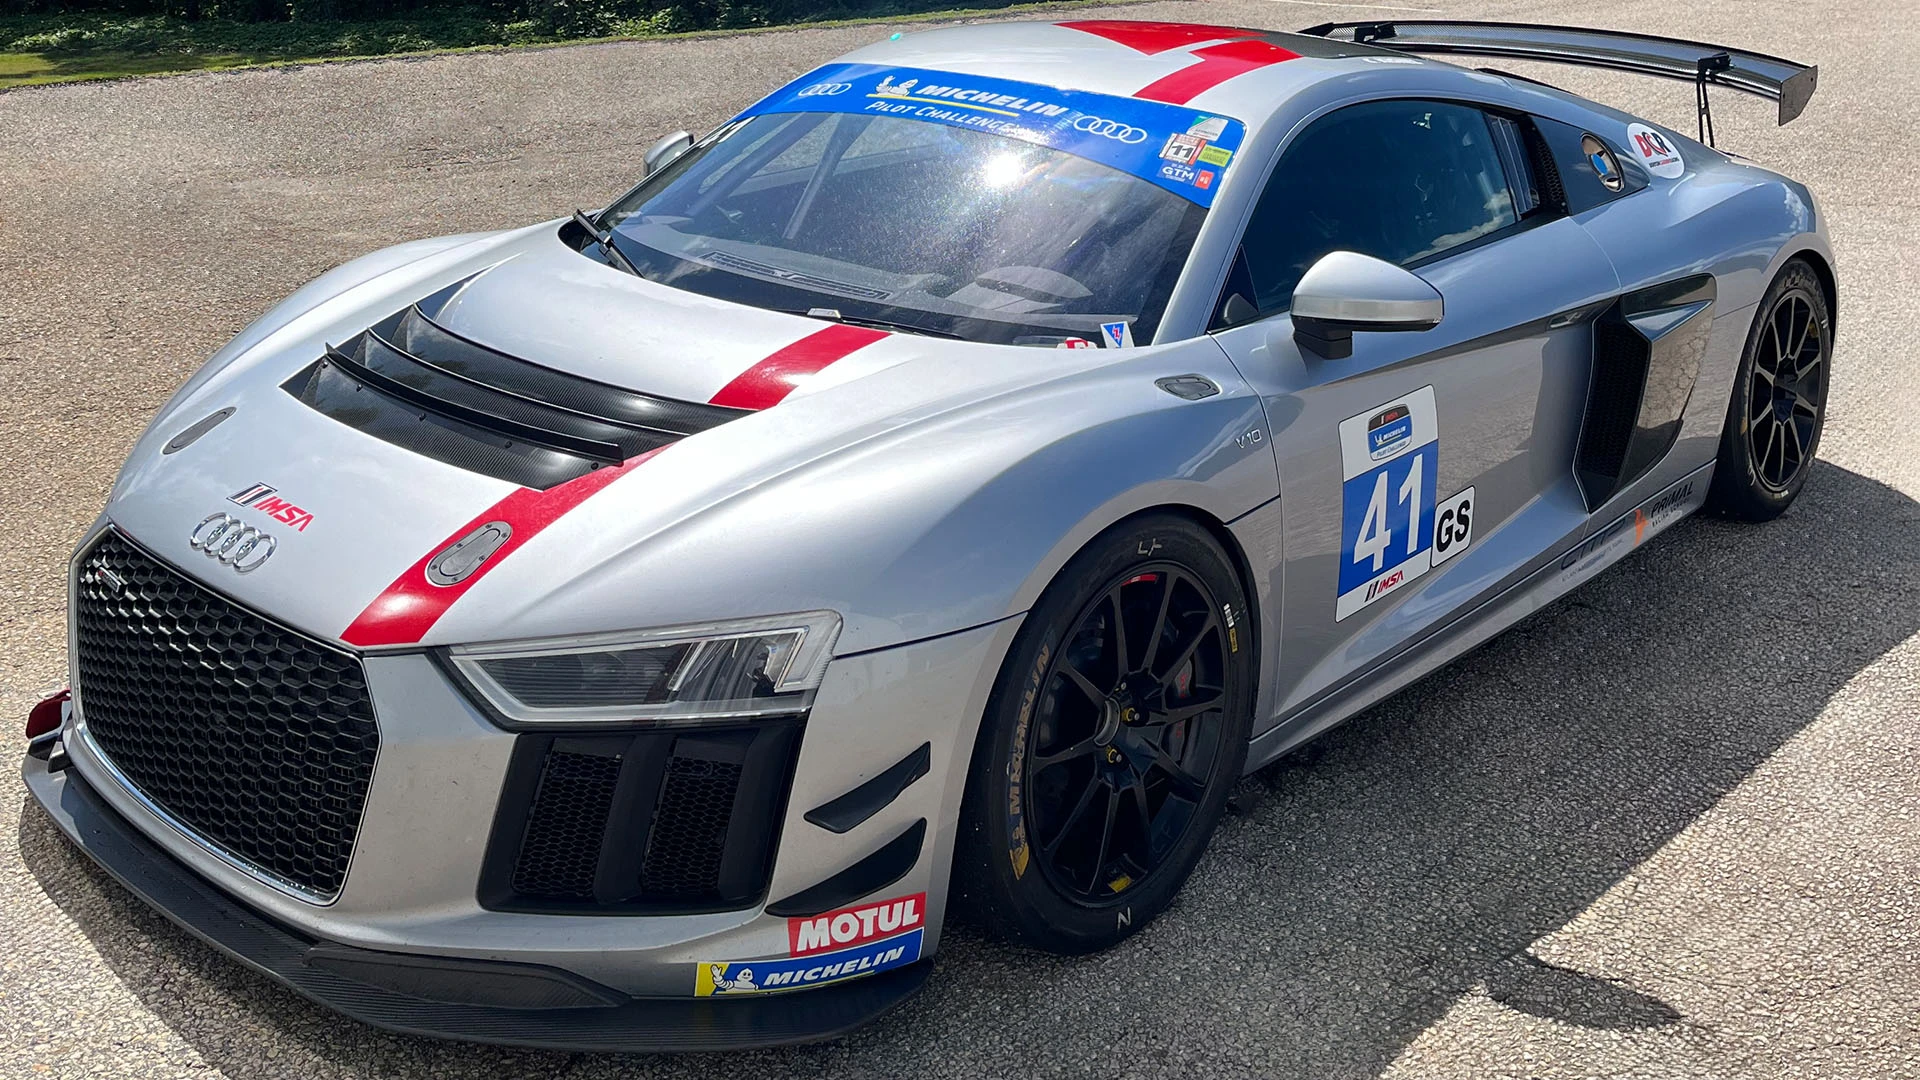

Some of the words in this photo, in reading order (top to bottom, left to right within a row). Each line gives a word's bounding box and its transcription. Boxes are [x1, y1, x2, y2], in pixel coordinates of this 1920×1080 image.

[865, 101, 917, 114] PILOT
[914, 106, 1015, 132] CHALLENGE
[915, 84, 1069, 116] MICHELIN
[1171, 144, 1195, 159] 11
[1162, 166, 1195, 180] GTM
[1235, 429, 1262, 448] V10
[253, 496, 314, 532] IMSA
[1353, 453, 1423, 572] 41
[1651, 480, 1693, 518] PRIMAL
[1436, 499, 1471, 552] GS
[1376, 570, 1404, 593] IMSA
[796, 899, 919, 952] MOTUL
[763, 945, 906, 986] MICHELIN
